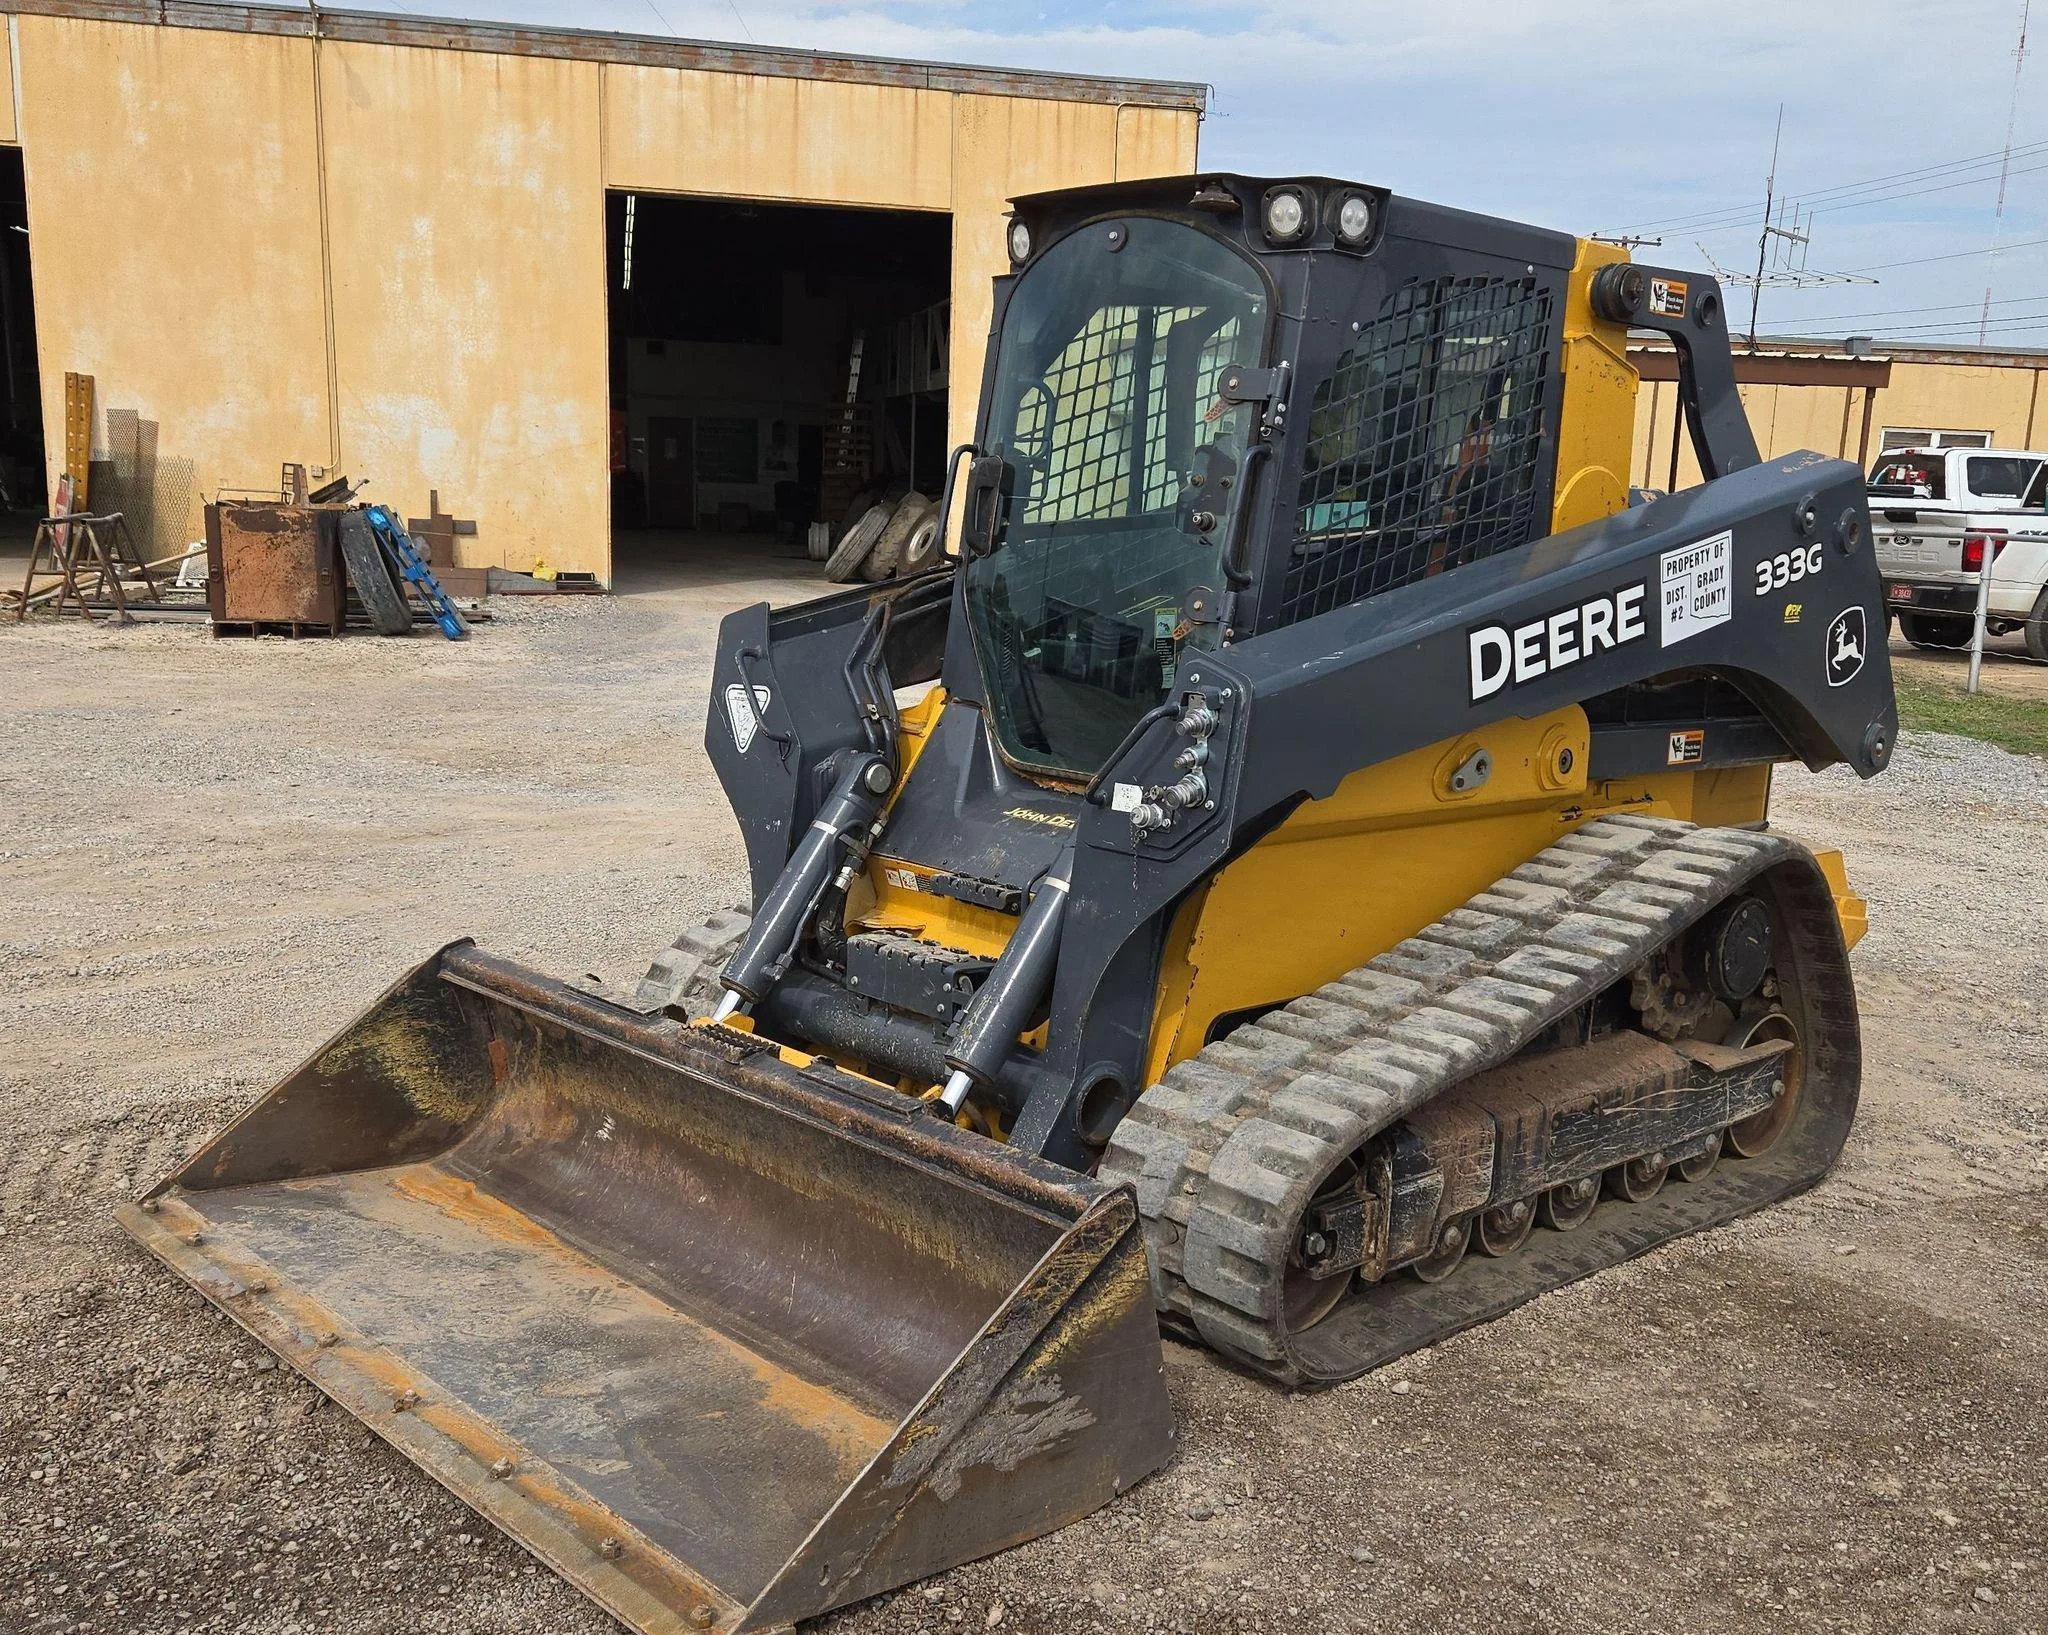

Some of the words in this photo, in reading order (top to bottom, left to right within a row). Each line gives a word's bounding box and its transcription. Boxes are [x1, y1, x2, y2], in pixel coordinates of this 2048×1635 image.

[1666, 547, 1710, 577] PROPERTY
[1714, 542, 1724, 560] OF
[1755, 542, 1822, 596] 333G
[1697, 565, 1724, 588] GRADY
[1666, 586, 1688, 606] DIST.
[1694, 586, 1726, 612] COUNTY
[1671, 606, 1684, 623] #2
[1470, 584, 1645, 700] DEERE
[1003, 807, 1051, 822] JOHN
